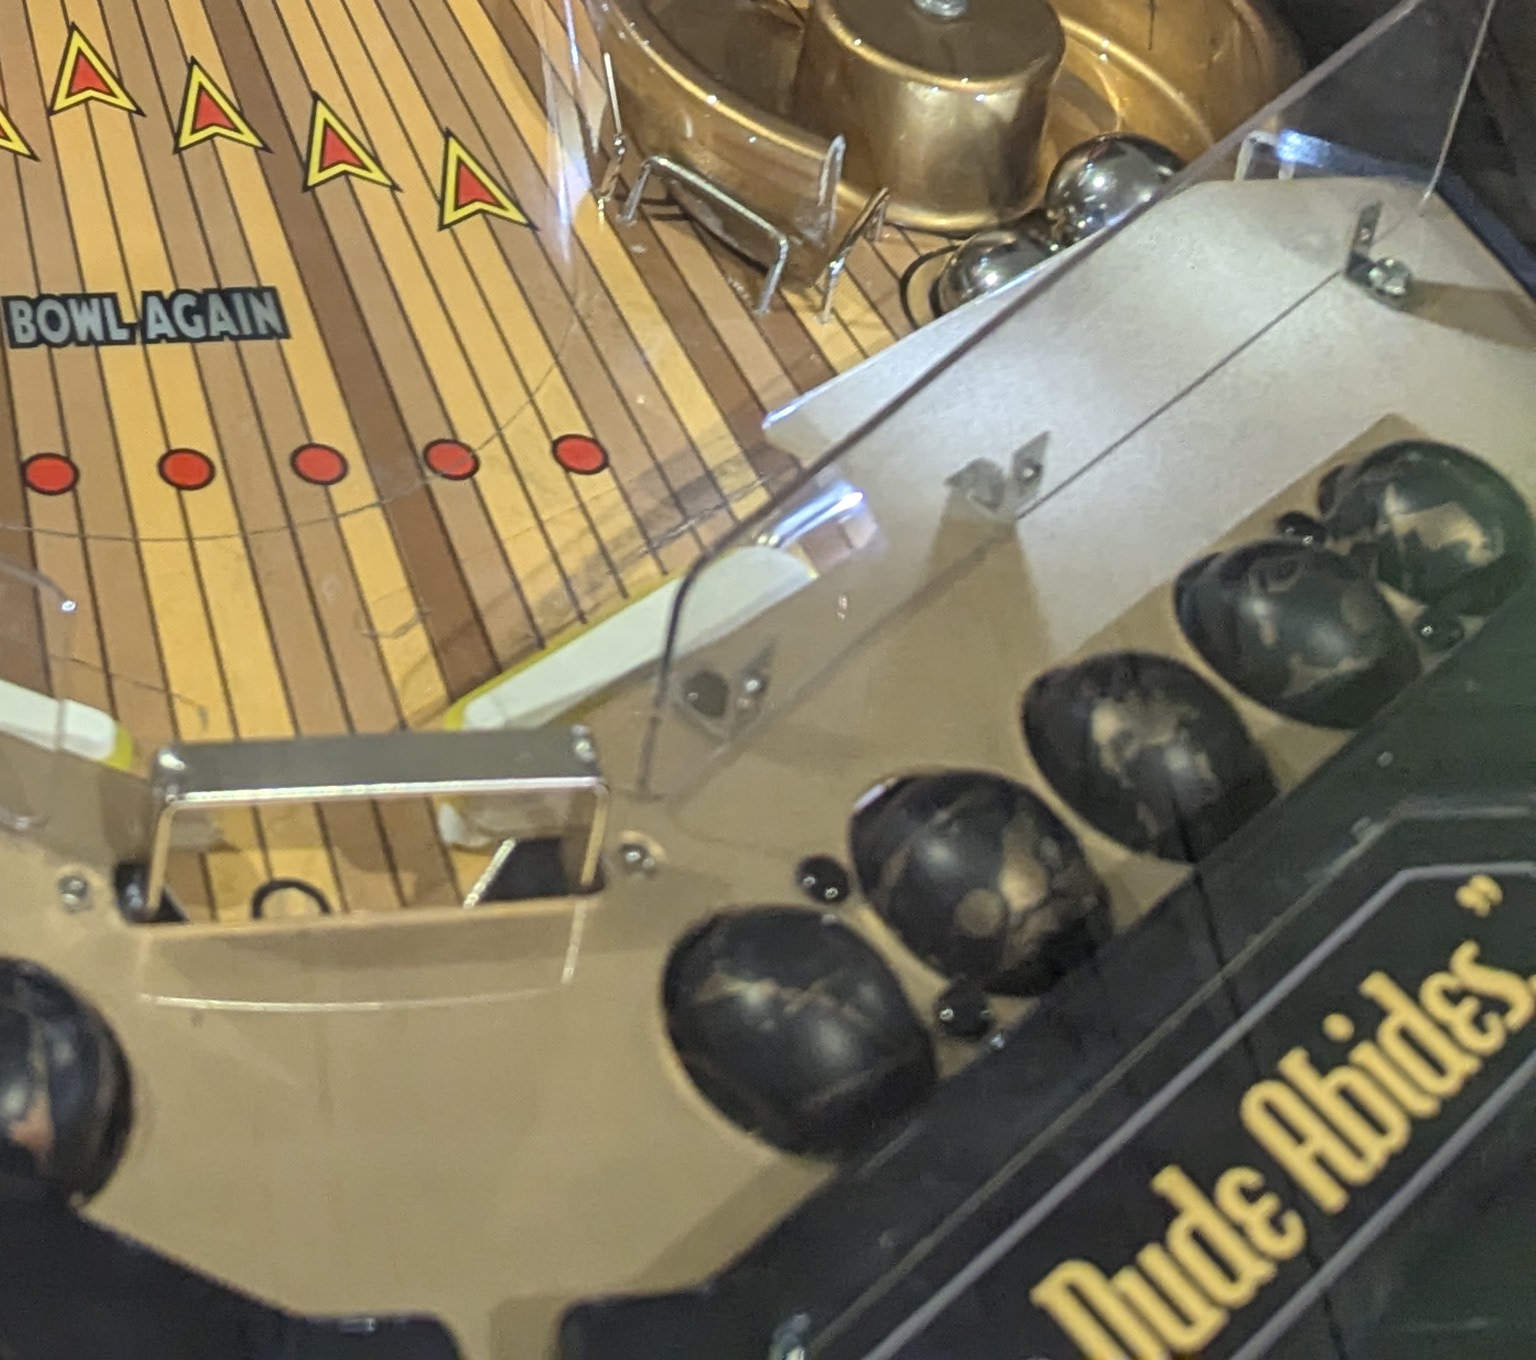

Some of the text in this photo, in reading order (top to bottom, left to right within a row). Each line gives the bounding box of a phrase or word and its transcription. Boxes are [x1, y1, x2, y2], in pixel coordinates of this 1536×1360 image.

[8, 290, 286, 345] BOWL AGAIN
[1029, 1164, 1306, 1360] Dude
